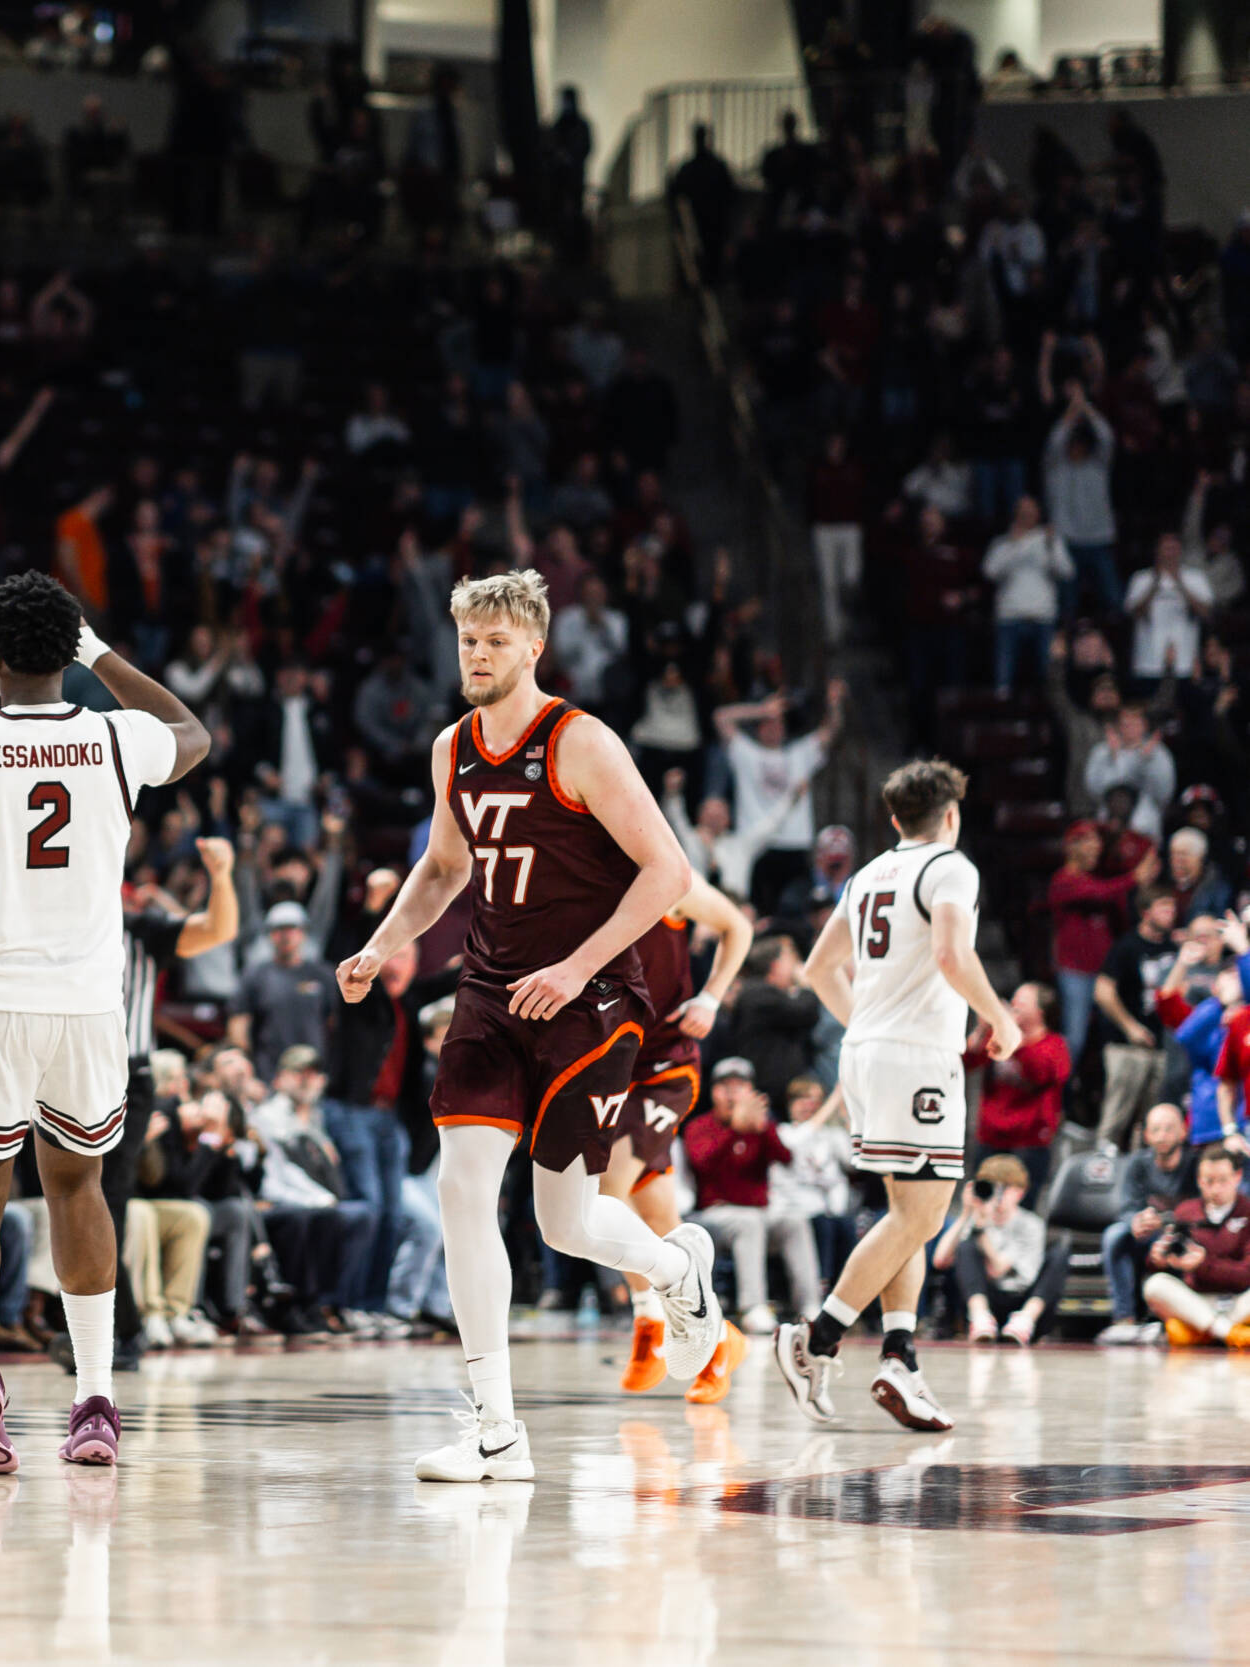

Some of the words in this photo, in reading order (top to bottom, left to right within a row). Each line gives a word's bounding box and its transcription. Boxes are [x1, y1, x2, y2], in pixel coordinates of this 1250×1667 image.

[26, 781, 71, 869] 2
[458, 790, 535, 841] VT
[473, 844, 536, 906] 77
[858, 891, 896, 960] 15
[588, 1087, 629, 1129] VT
[643, 1098, 679, 1133] VT
